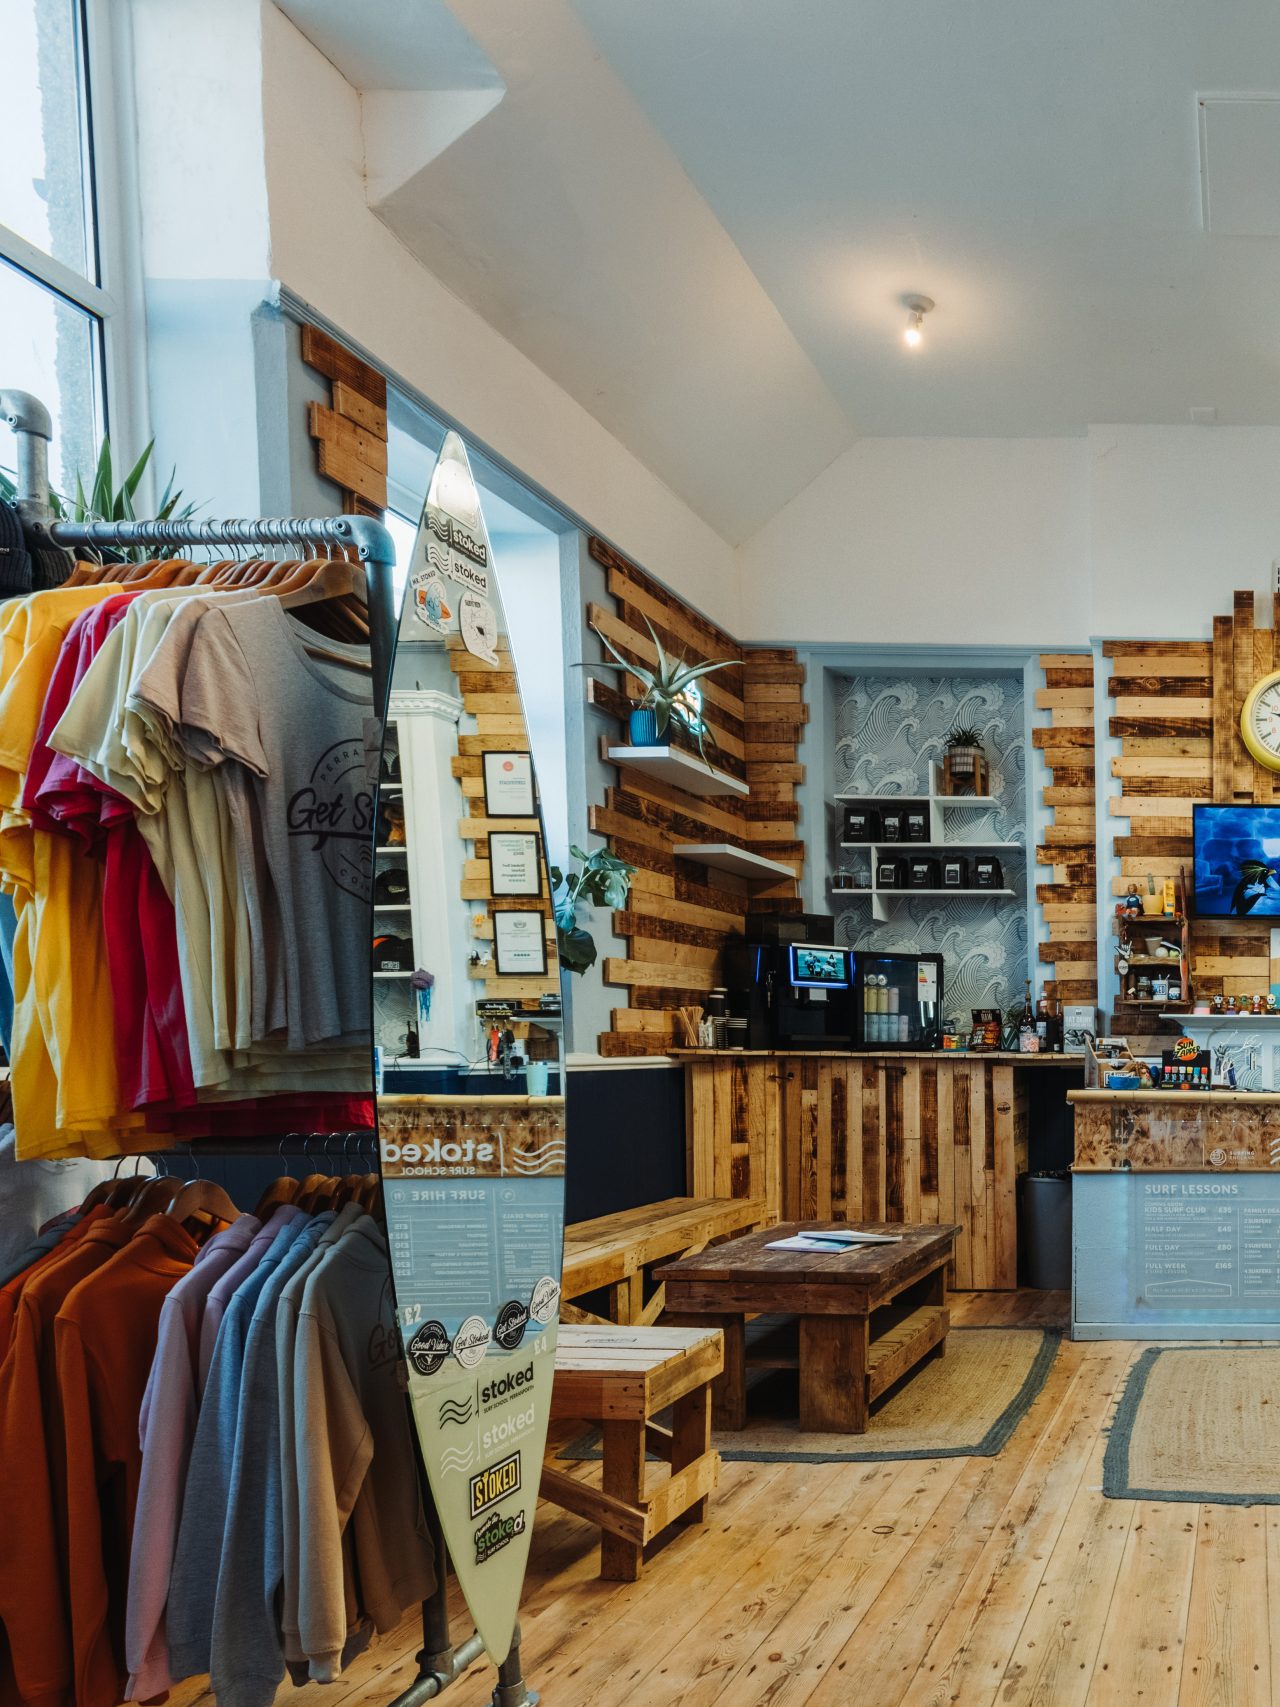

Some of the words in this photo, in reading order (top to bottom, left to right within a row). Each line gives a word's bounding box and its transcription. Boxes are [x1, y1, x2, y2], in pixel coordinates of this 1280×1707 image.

[453, 531, 486, 560] stoked
[454, 563, 486, 588] stoked
[287, 788, 349, 830] Get
[1173, 1045, 1202, 1060] ZAPPER
[1177, 1041, 1194, 1050] SUN
[1145, 1184, 1177, 1194] SURF
[1182, 1184, 1238, 1194] LESSONS
[404, 1304, 422, 1326] £2
[411, 1337, 431, 1350] Good
[431, 1338, 449, 1351] Vibes
[468, 1330, 490, 1346] Stoked
[482, 1361, 534, 1403] stoked
[483, 1405, 493, 1414] SURF
[493, 1398, 508, 1409] SCHOOL
[482, 1403, 535, 1449] stoked
[475, 1461, 517, 1507] STOKED
[478, 1512, 524, 1552] stoked
